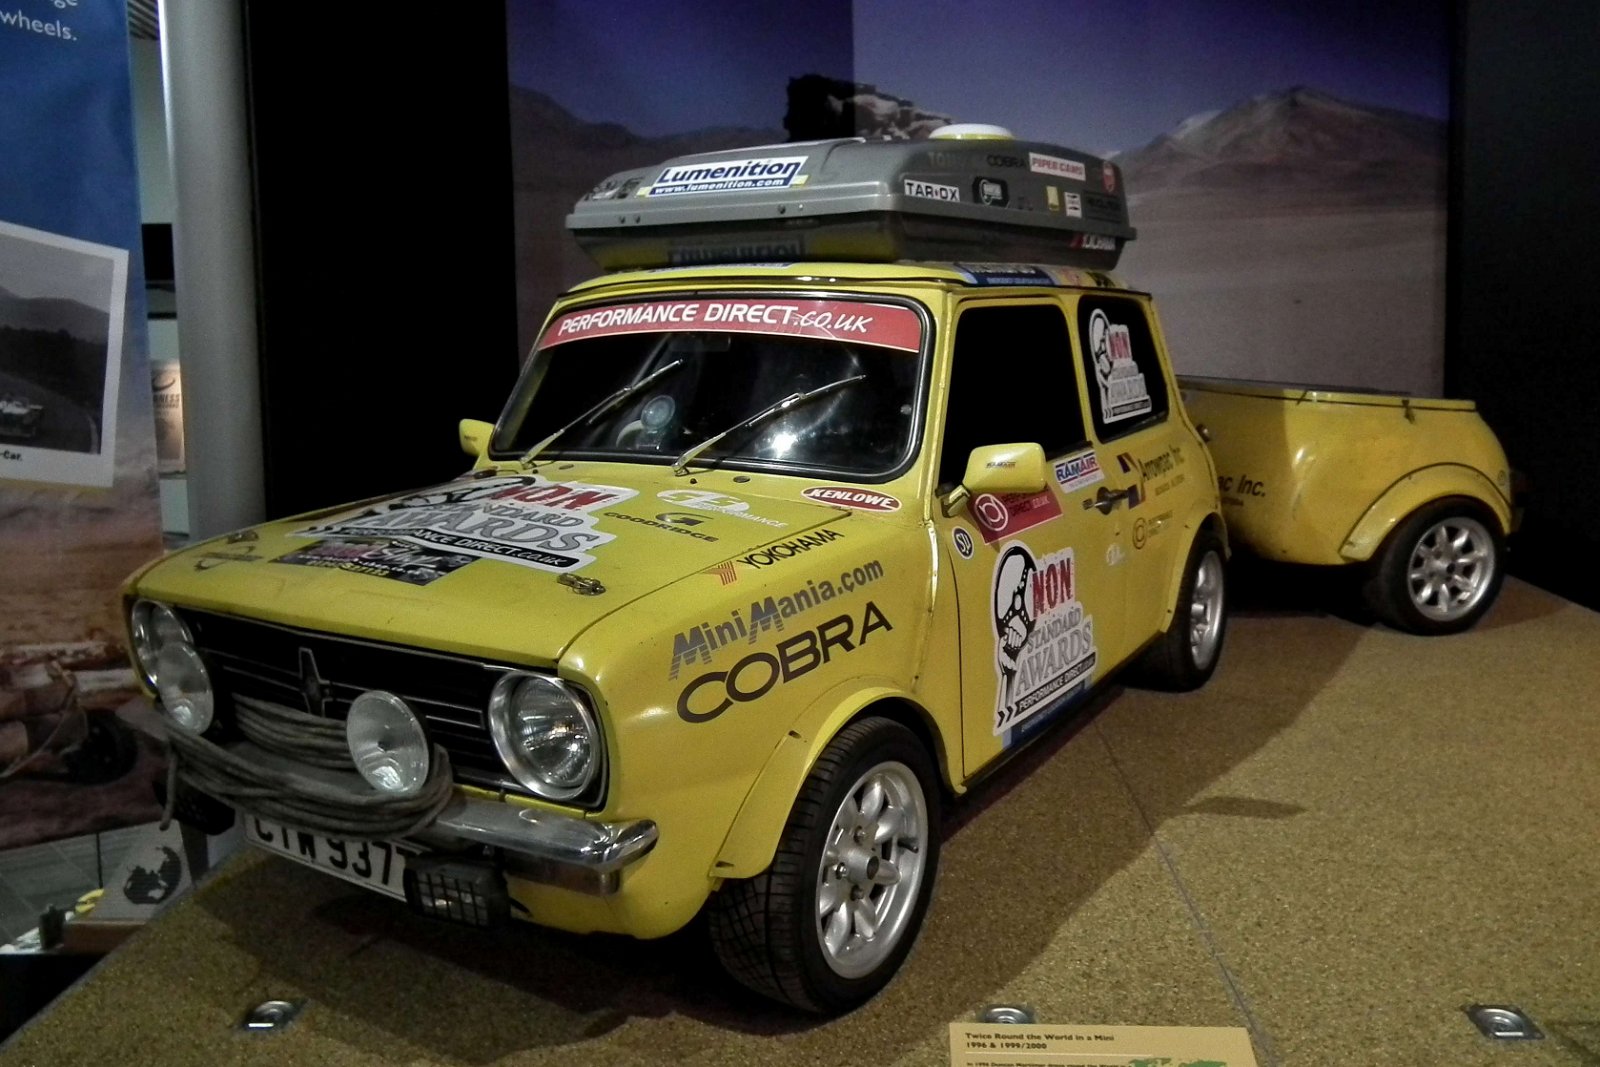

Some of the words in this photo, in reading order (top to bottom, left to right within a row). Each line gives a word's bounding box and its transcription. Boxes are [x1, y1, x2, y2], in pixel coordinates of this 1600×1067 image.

[0, 9, 77, 40] wheels.
[655, 178, 784, 195] www.lumenition.com
[657, 161, 801, 184] Lumenition
[558, 303, 700, 337] PERFORMANCE
[1056, 456, 1098, 481] RAMAIR
[485, 484, 618, 510] NON
[810, 487, 893, 508] KENLOWE
[1237, 474, 1265, 497] Inc.
[737, 529, 845, 570] YOKOHAMA
[1032, 558, 1072, 618] NON
[668, 560, 884, 681] MiniMania.com
[1027, 607, 1081, 654] STANDARD
[677, 601, 893, 724] COBRA
[1015, 621, 1093, 696] AWARDS
[1018, 675, 1065, 713] PERFORMANCE
[965, 1032, 992, 1040] Twice
